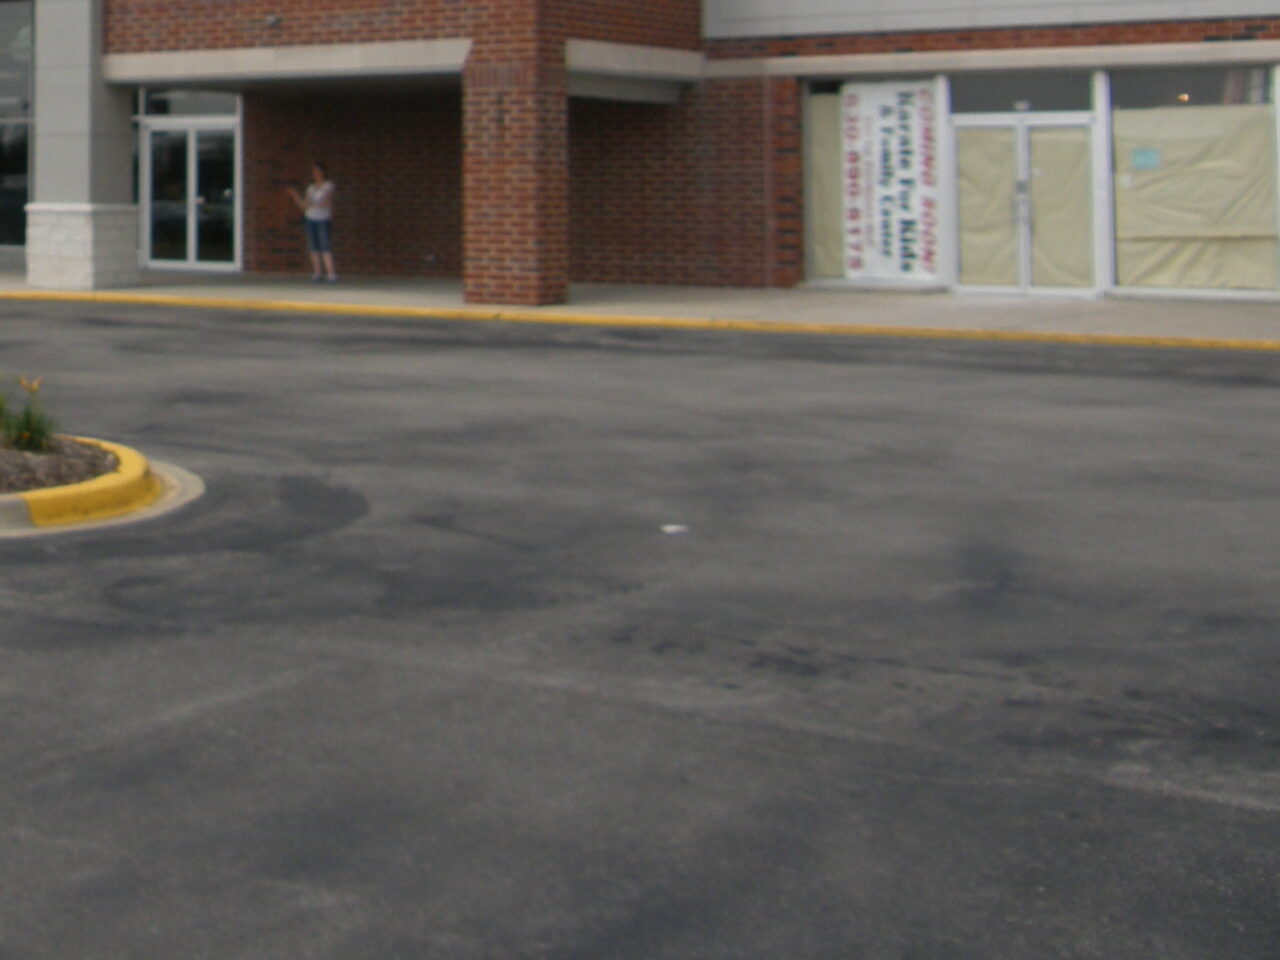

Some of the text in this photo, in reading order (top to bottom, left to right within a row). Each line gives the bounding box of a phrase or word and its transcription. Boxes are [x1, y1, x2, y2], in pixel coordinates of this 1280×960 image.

[878, 126, 895, 187] Family
[896, 91, 917, 272] Karate For Kids
[880, 195, 894, 258] Center
